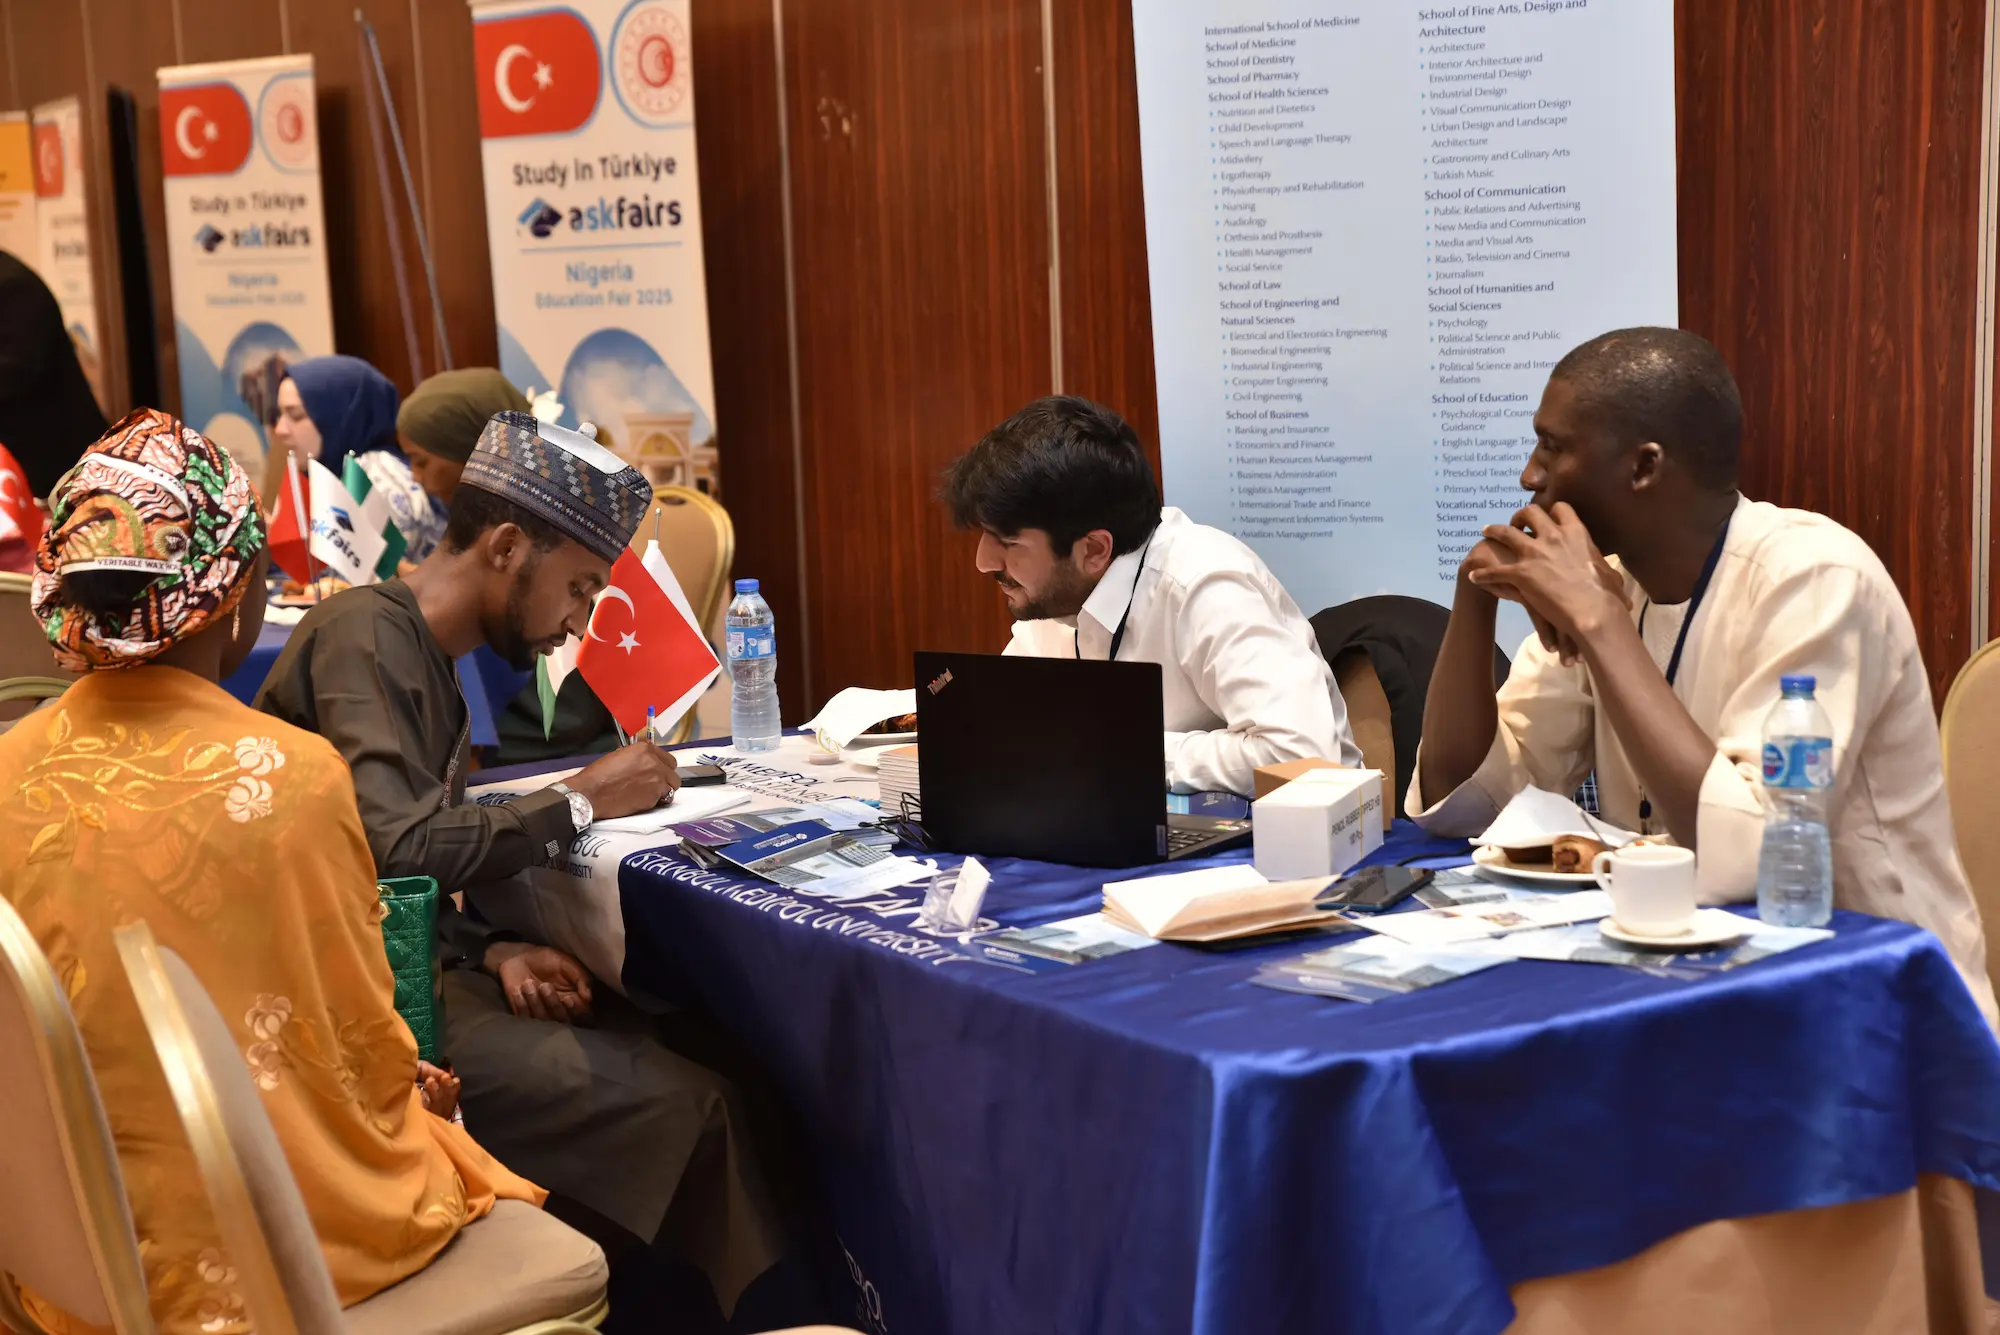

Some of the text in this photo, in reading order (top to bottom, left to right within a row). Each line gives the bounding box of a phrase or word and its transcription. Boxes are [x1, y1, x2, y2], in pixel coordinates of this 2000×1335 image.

[1419, 0, 1586, 20] School of Fine Arts, Design and
[1205, 17, 1360, 36] International School of Medicine
[1419, 26, 1485, 38] Architecture
[1206, 39, 1296, 52] School of Medicine
[1429, 43, 1485, 54] Architecture
[1207, 55, 1295, 68] School of Dentistry
[1429, 53, 1542, 69] Interior Architecture and
[1207, 72, 1299, 84] School of Pharmacy
[1429, 69, 1531, 83] Environmental Design
[1209, 88, 1329, 102] School of Health Sciences
[1430, 87, 1507, 99] Industrial Design
[1430, 100, 1571, 116] Visual Communication Design
[1431, 117, 1567, 132] Urban Design and Landscape
[1431, 138, 1488, 148] Architecture
[1432, 148, 1570, 164] Gastronomy and Culinary Arts
[513, 161, 567, 189] Study
[598, 152, 677, 182] Türkiye
[1433, 170, 1494, 180] Turkish Music
[1425, 185, 1565, 200] School of Communication
[569, 194, 682, 231] askfairs
[1434, 201, 1580, 216] Public Relations and Advertising
[1435, 217, 1586, 232] New Media and Communication
[231, 222, 311, 247] askfairs
[1435, 235, 1533, 247] Media and Visual Arts
[1435, 250, 1570, 263] Radio, Television and Cinema
[566, 259, 634, 288] Nigeria
[1226, 263, 1282, 272] Social Service
[1436, 269, 1484, 279] Journalism
[1219, 280, 1281, 290] School of Law
[1428, 281, 1554, 296] School of Humanities and
[535, 291, 604, 309] Education
[608, 289, 631, 305] Fair
[1220, 297, 1339, 310] School of Engineering and
[1429, 301, 1501, 312] Social Sciences
[1221, 316, 1295, 326] Natural Sciences
[1438, 317, 1488, 329] Psychology
[1438, 331, 1560, 343] Political Science and Public
[1439, 347, 1505, 356] Administration
[1439, 360, 1530, 371] Political Science and
[1440, 375, 1480, 384] Relations
[1432, 393, 1528, 403] School of Education
[1226, 410, 1309, 419] School of Business
[1441, 409, 1501, 420] Psychological
[1441, 422, 1485, 431] Guidance
[1442, 437, 1518, 448] English Language
[1442, 452, 1521, 464] Special Education
[1237, 470, 1337, 479] Business Administration
[1443, 467, 1524, 477] Preschool Teachin
[1444, 484, 1524, 495] Primary Mathema
[1436, 499, 1522, 509] Vocational School
[1240, 514, 1383, 525] Management Information Systems
[1437, 512, 1477, 521] Sciences
[1437, 527, 1484, 537] Vocationa
[311, 518, 361, 568] skfairs
[1438, 543, 1472, 552] Vocatio
[97, 558, 142, 568] VERITABLE
